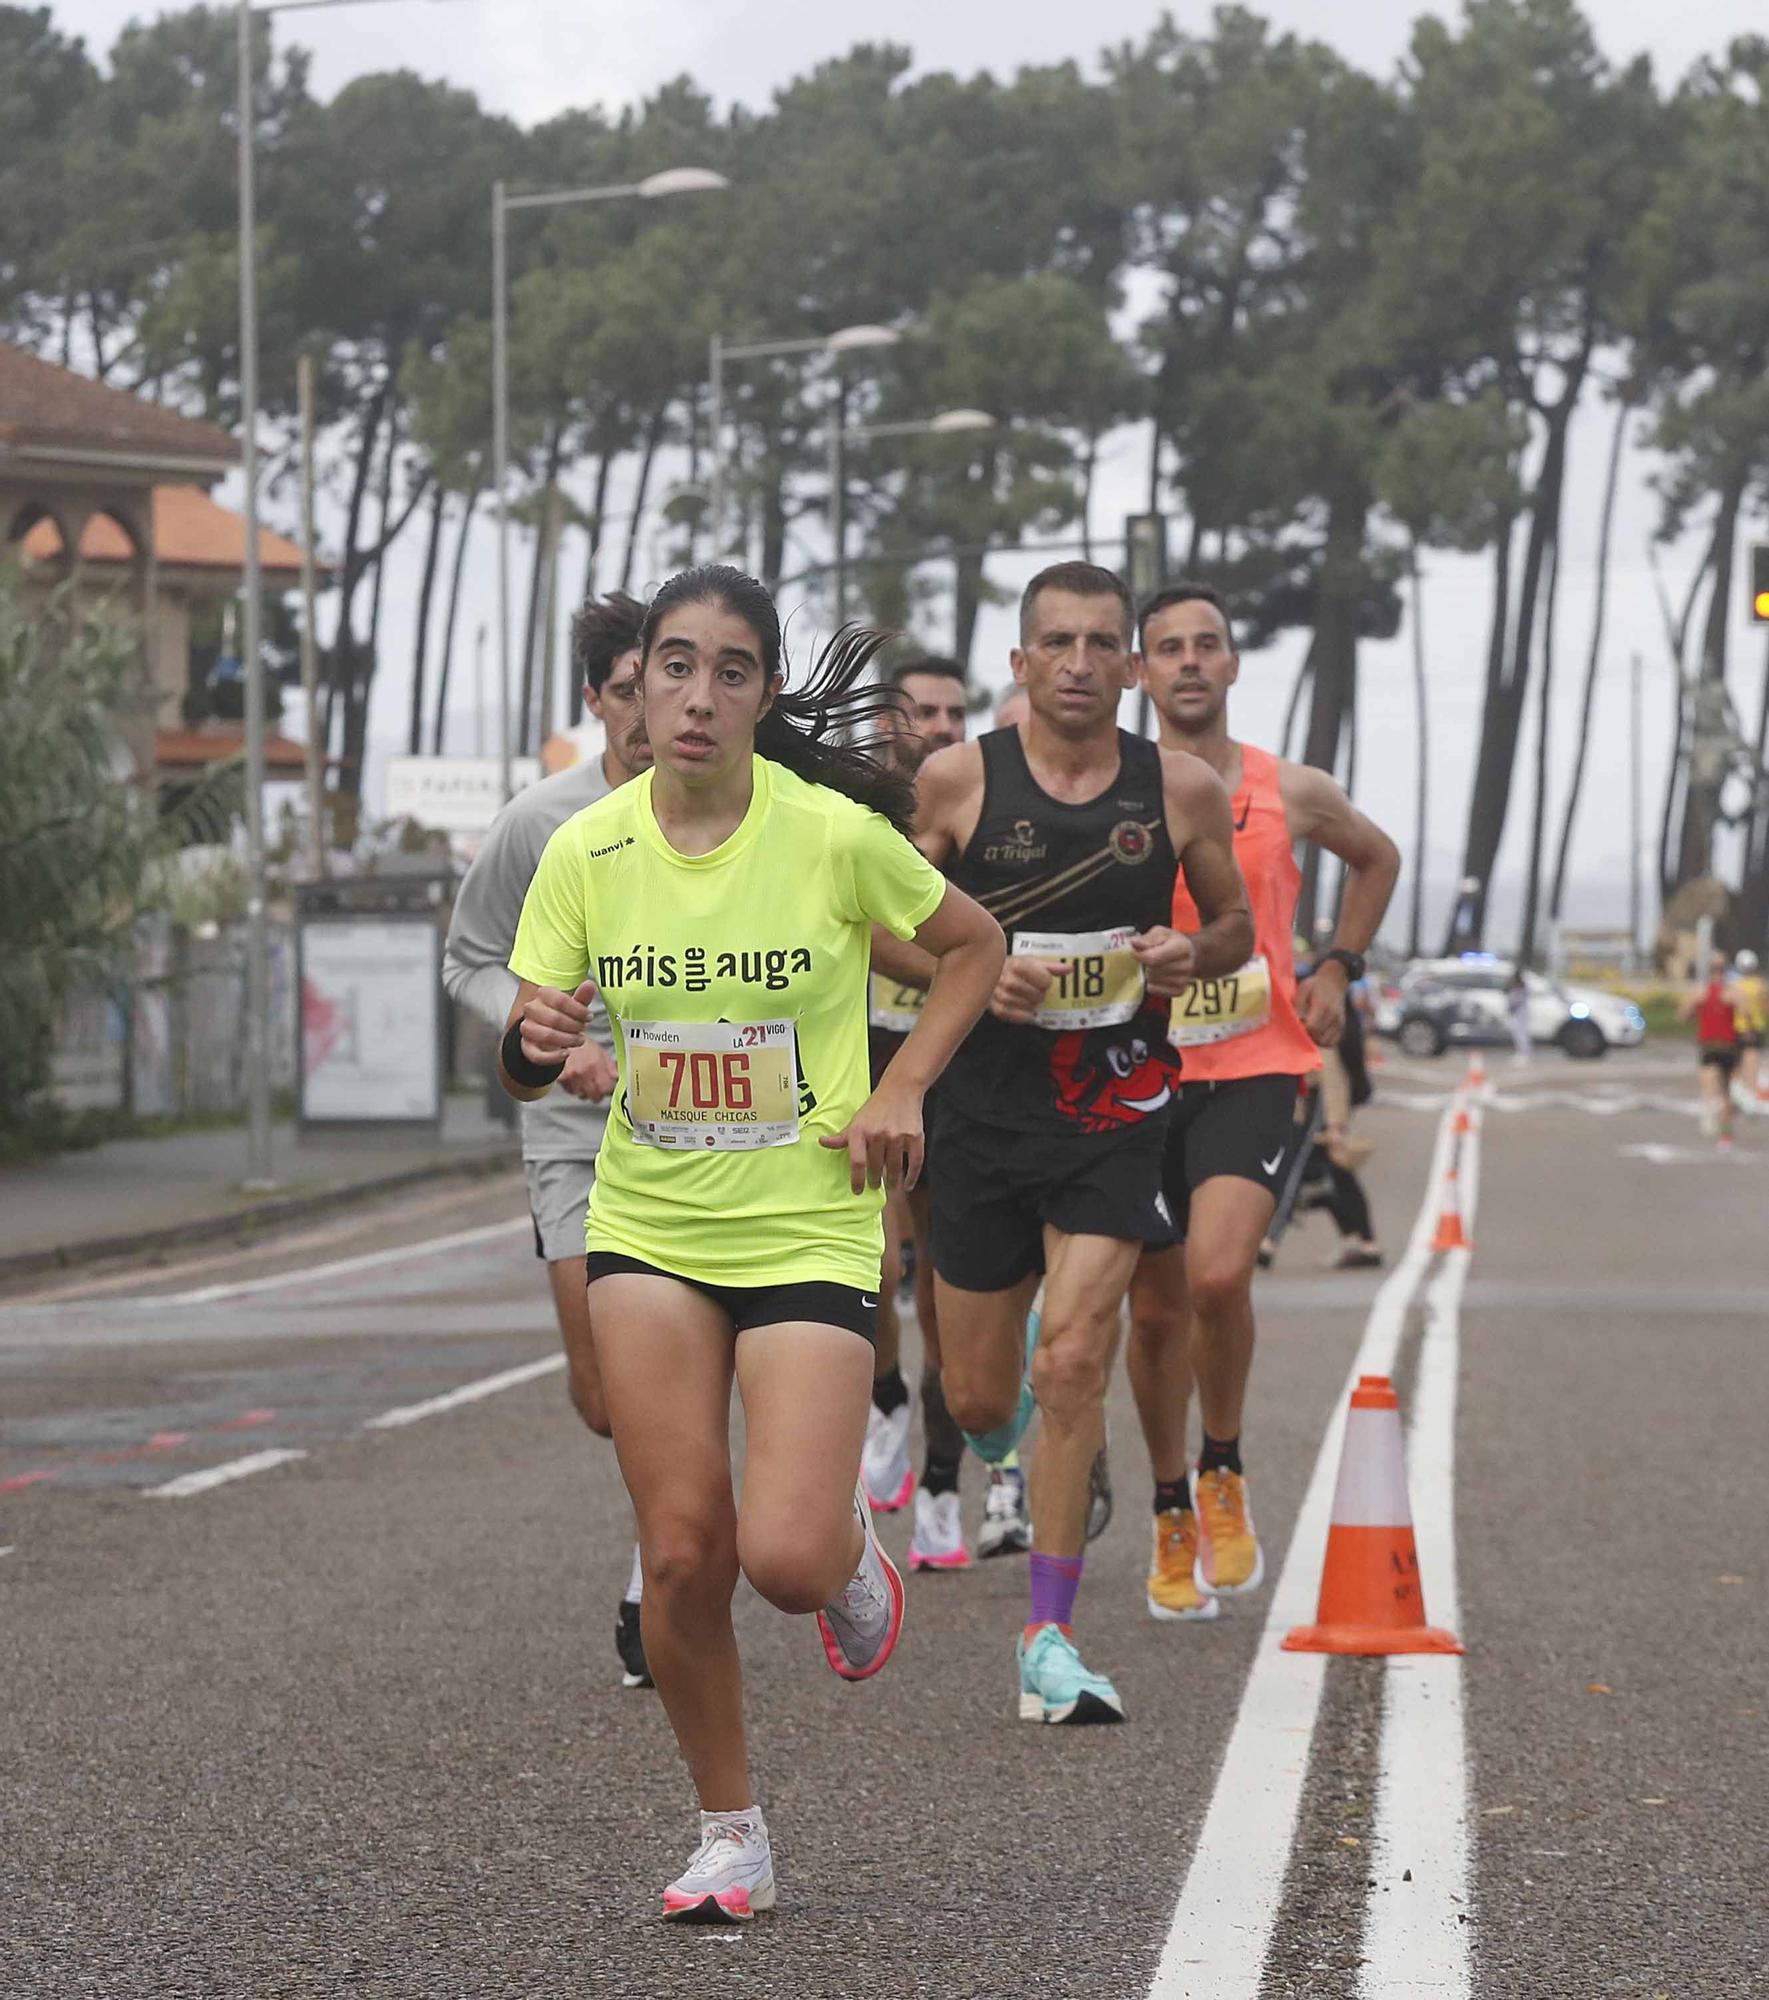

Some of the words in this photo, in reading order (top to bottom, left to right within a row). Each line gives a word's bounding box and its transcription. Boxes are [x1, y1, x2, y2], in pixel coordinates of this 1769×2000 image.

[590, 839, 624, 859] luanvi
[1001, 843, 1047, 864] Trigal
[597, 944, 678, 988] máis
[684, 947, 712, 992] que
[716, 947, 812, 990] auga
[1183, 977, 1239, 1018] 297
[642, 1029, 680, 1044] howden
[733, 1037, 744, 1049] LA
[742, 1024, 767, 1047] 21
[766, 1023, 786, 1035] VIGO
[659, 1051, 753, 1110] 706
[660, 1110, 708, 1123] MAISQUE
[714, 1111, 758, 1122] CHICAS
